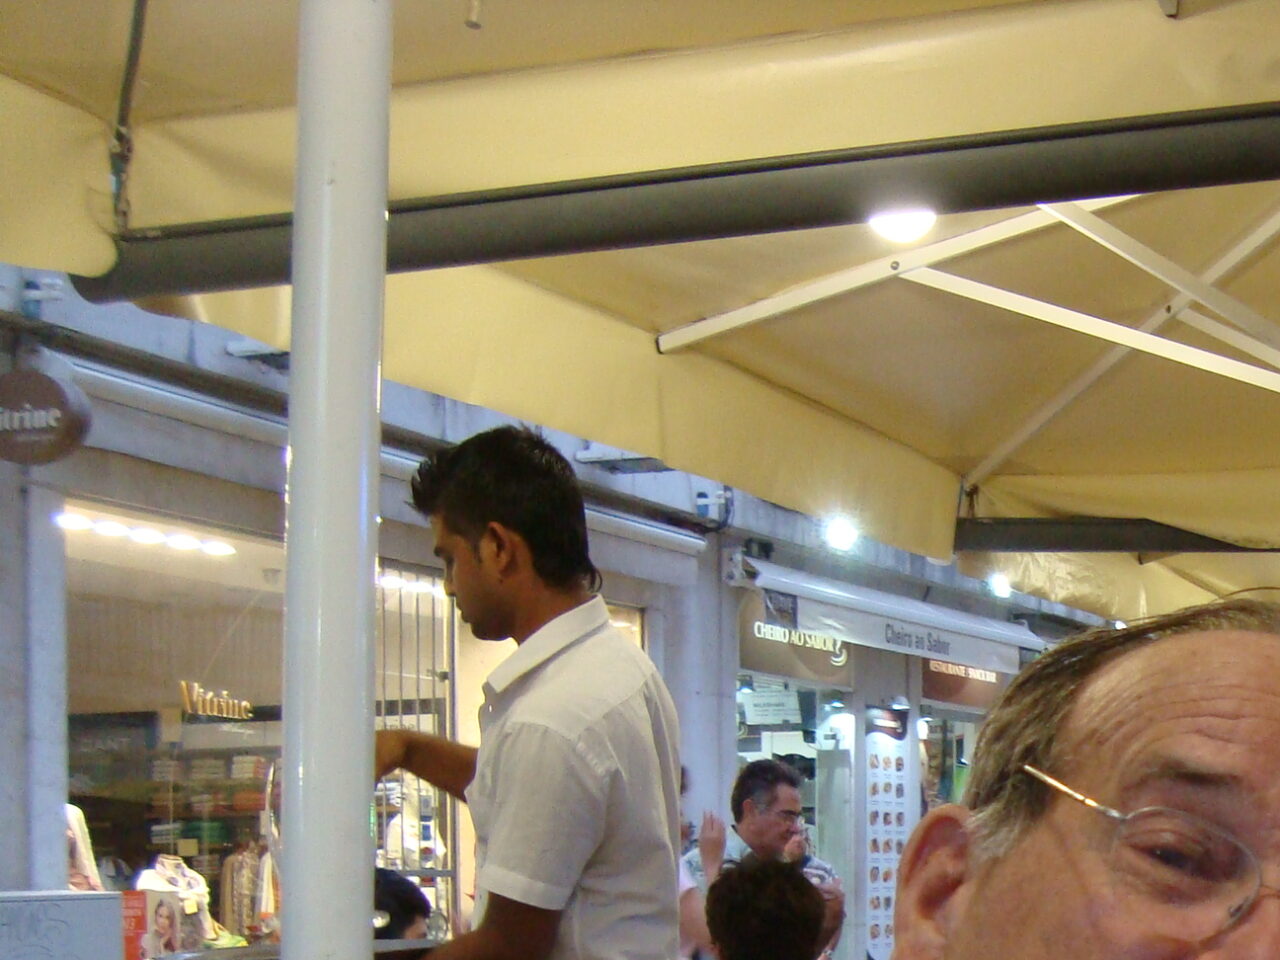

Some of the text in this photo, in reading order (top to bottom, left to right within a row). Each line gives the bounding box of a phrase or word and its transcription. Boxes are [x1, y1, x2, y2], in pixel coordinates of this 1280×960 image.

[754, 621, 835, 652] CHEIRO AO SABOR
[885, 623, 913, 649] Cheiro
[927, 631, 951, 656] Sabor
[180, 680, 254, 719] Vitrine
